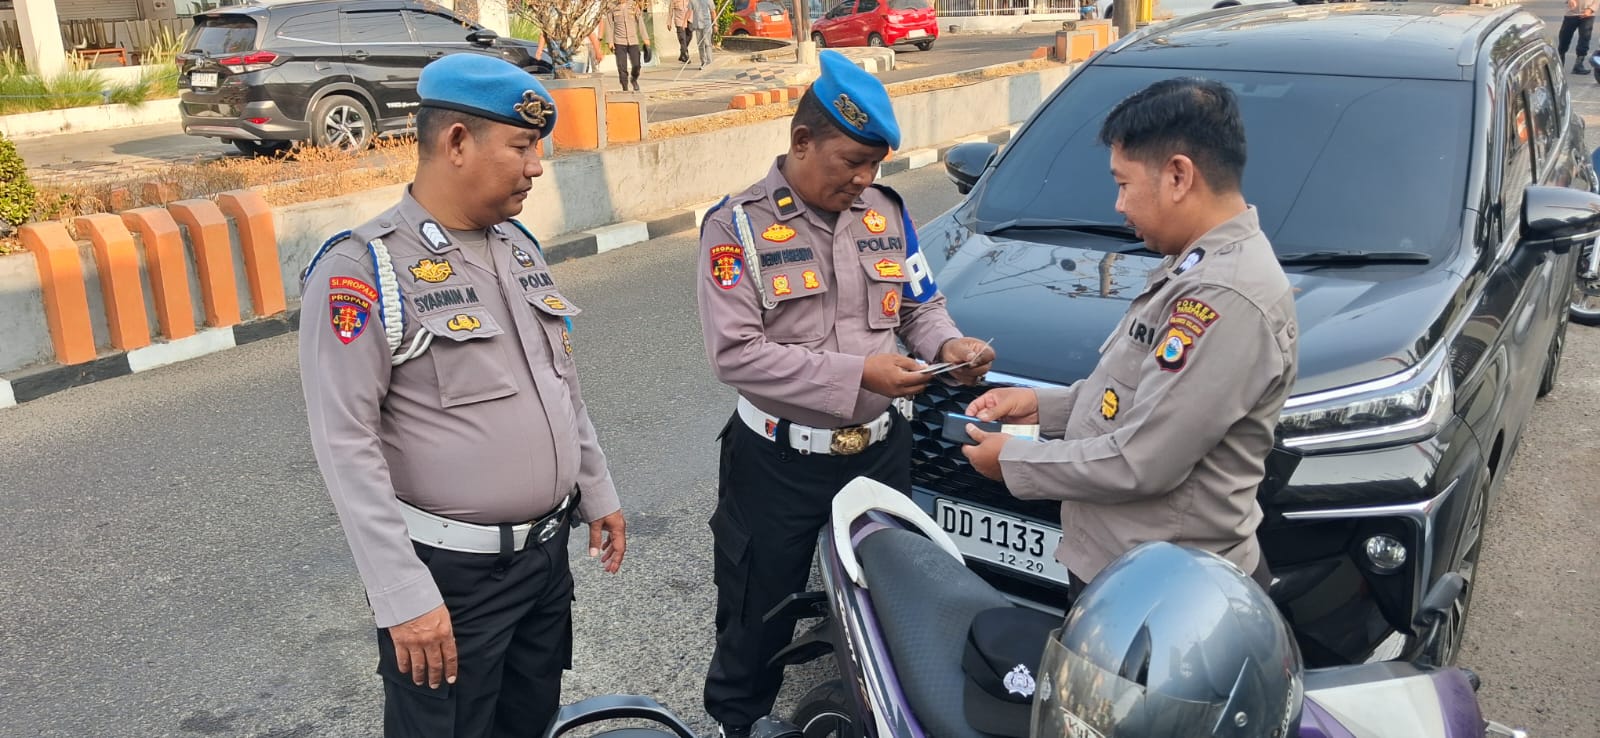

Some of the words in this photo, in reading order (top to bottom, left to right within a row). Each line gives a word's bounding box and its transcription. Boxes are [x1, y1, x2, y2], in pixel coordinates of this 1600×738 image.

[856, 236, 903, 252] POLRI
[519, 272, 554, 291] POLRI
[331, 295, 369, 309] PROPAM
[1176, 300, 1216, 320] POLRES
[942, 505, 973, 538] DD
[980, 516, 1045, 558] 1133
